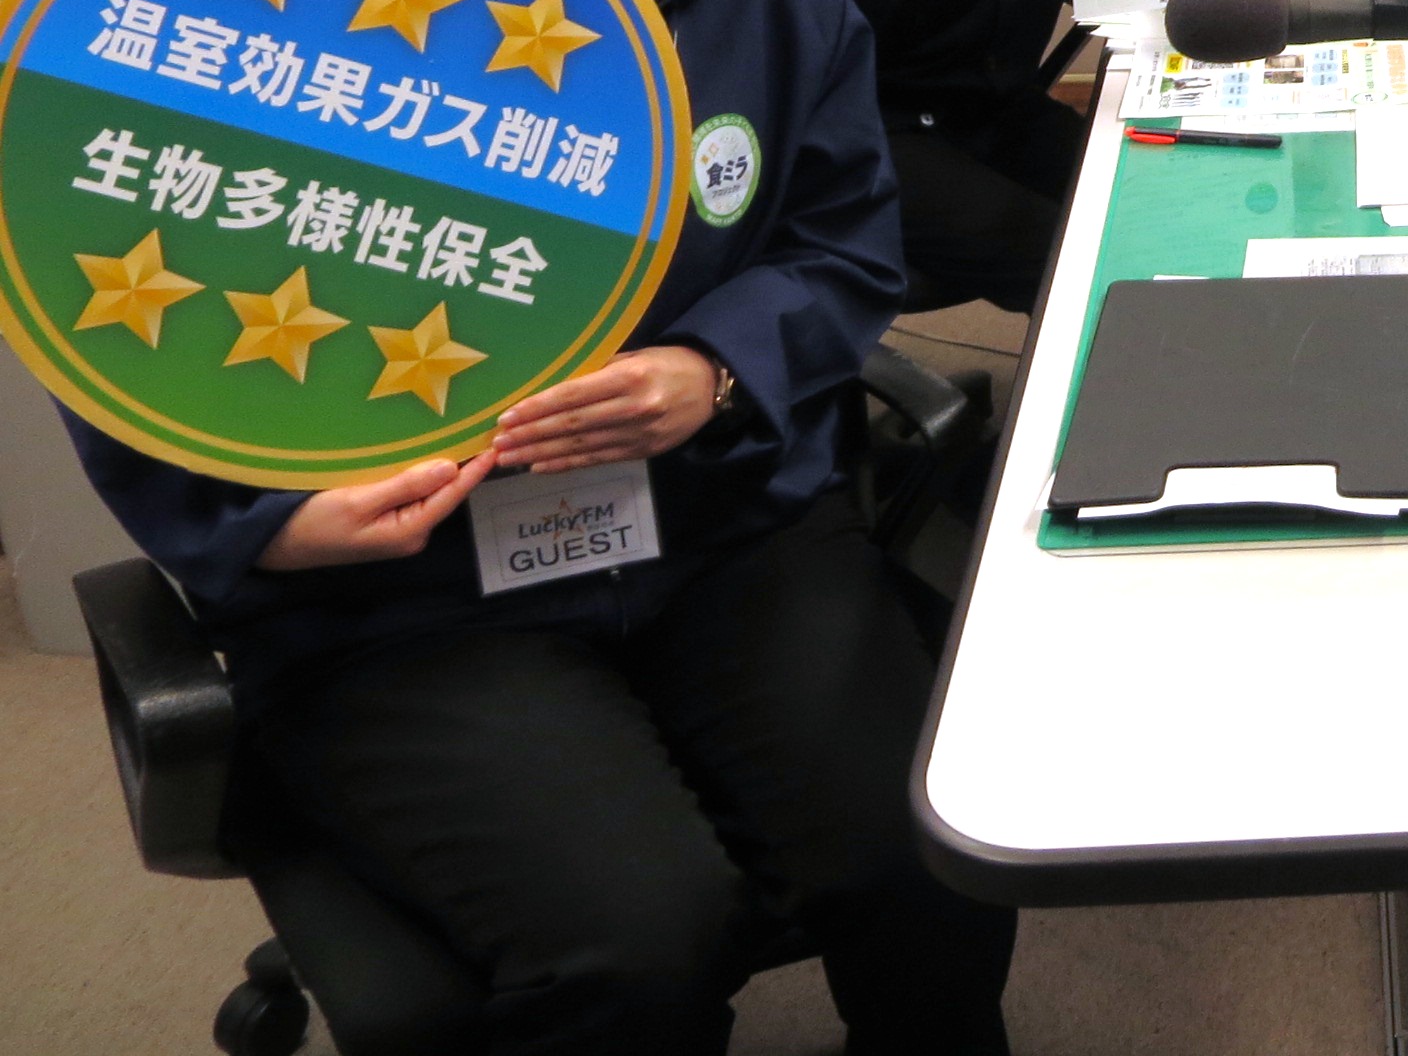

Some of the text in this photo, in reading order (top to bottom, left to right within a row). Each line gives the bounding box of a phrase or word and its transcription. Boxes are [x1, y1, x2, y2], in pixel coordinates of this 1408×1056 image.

[72, 129, 549, 305] 生物多様性保全
[509, 525, 633, 573] GUEST
